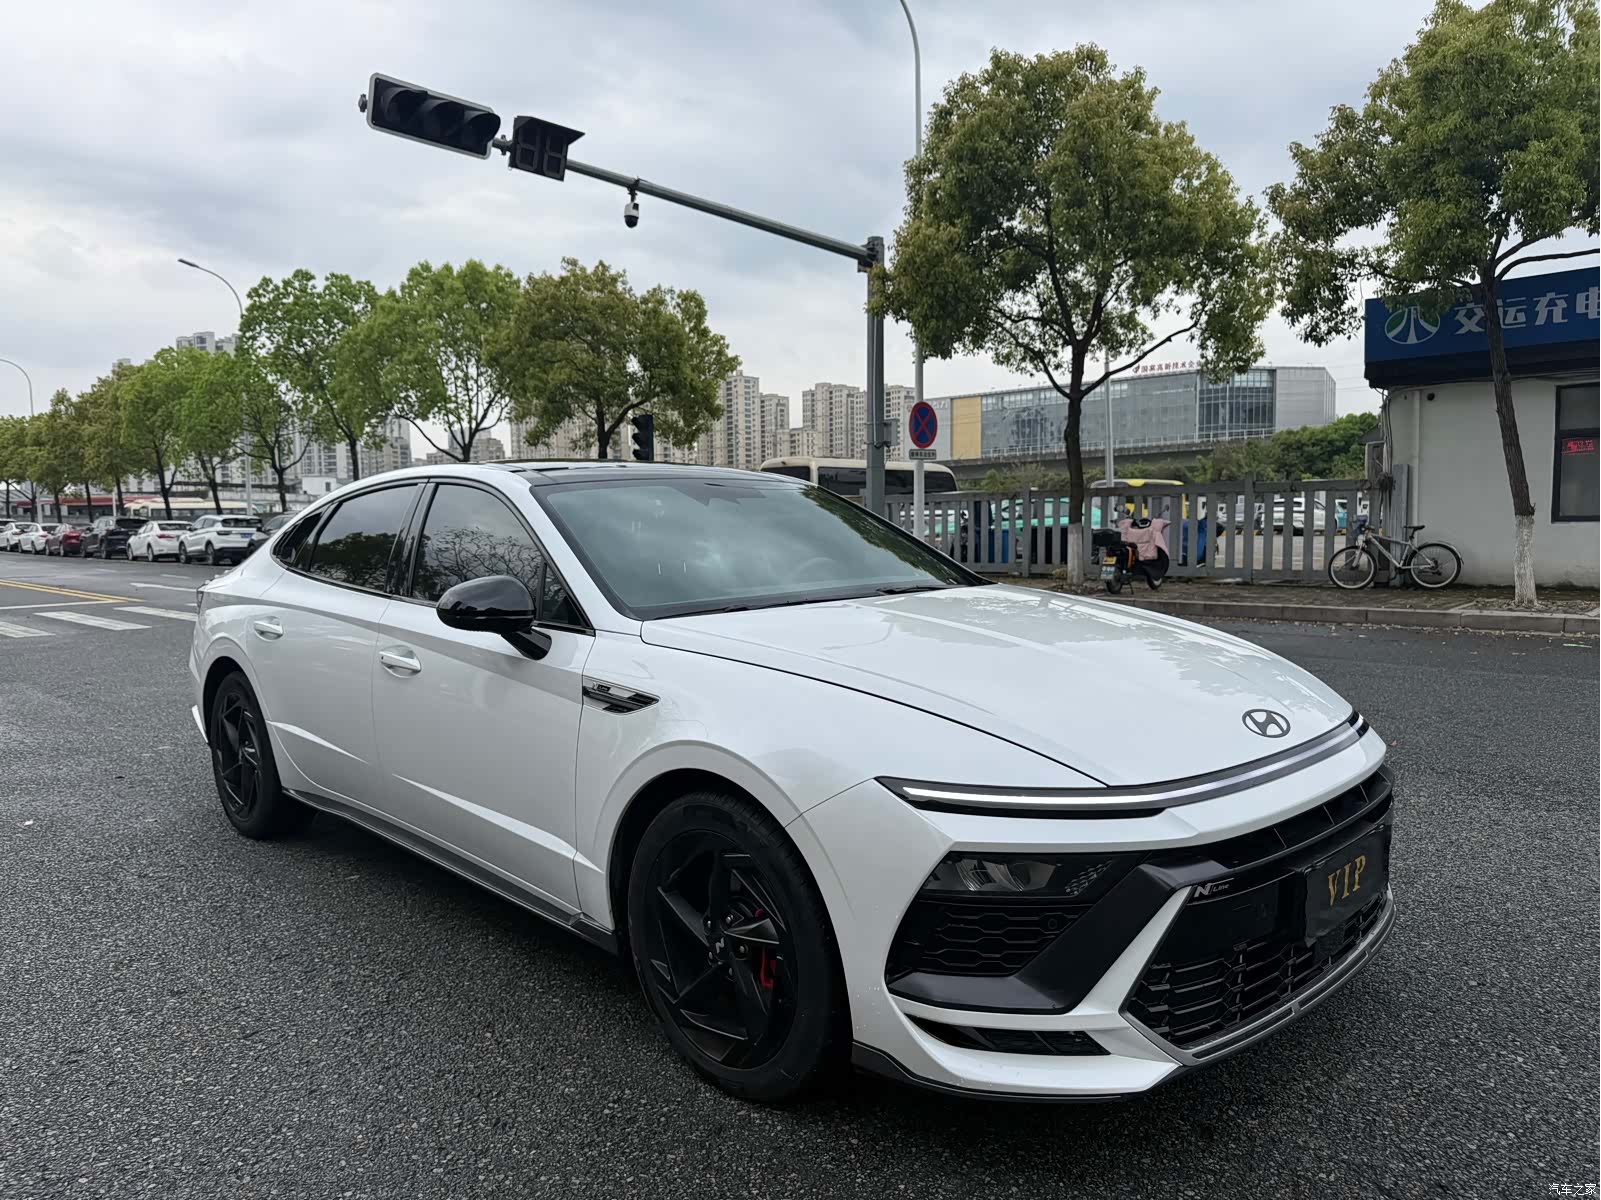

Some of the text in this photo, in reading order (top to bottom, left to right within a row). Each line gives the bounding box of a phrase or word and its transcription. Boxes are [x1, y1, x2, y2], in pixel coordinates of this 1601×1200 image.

[1454, 286, 1600, 335] 交运充电
[1327, 855, 1366, 907] VIP
